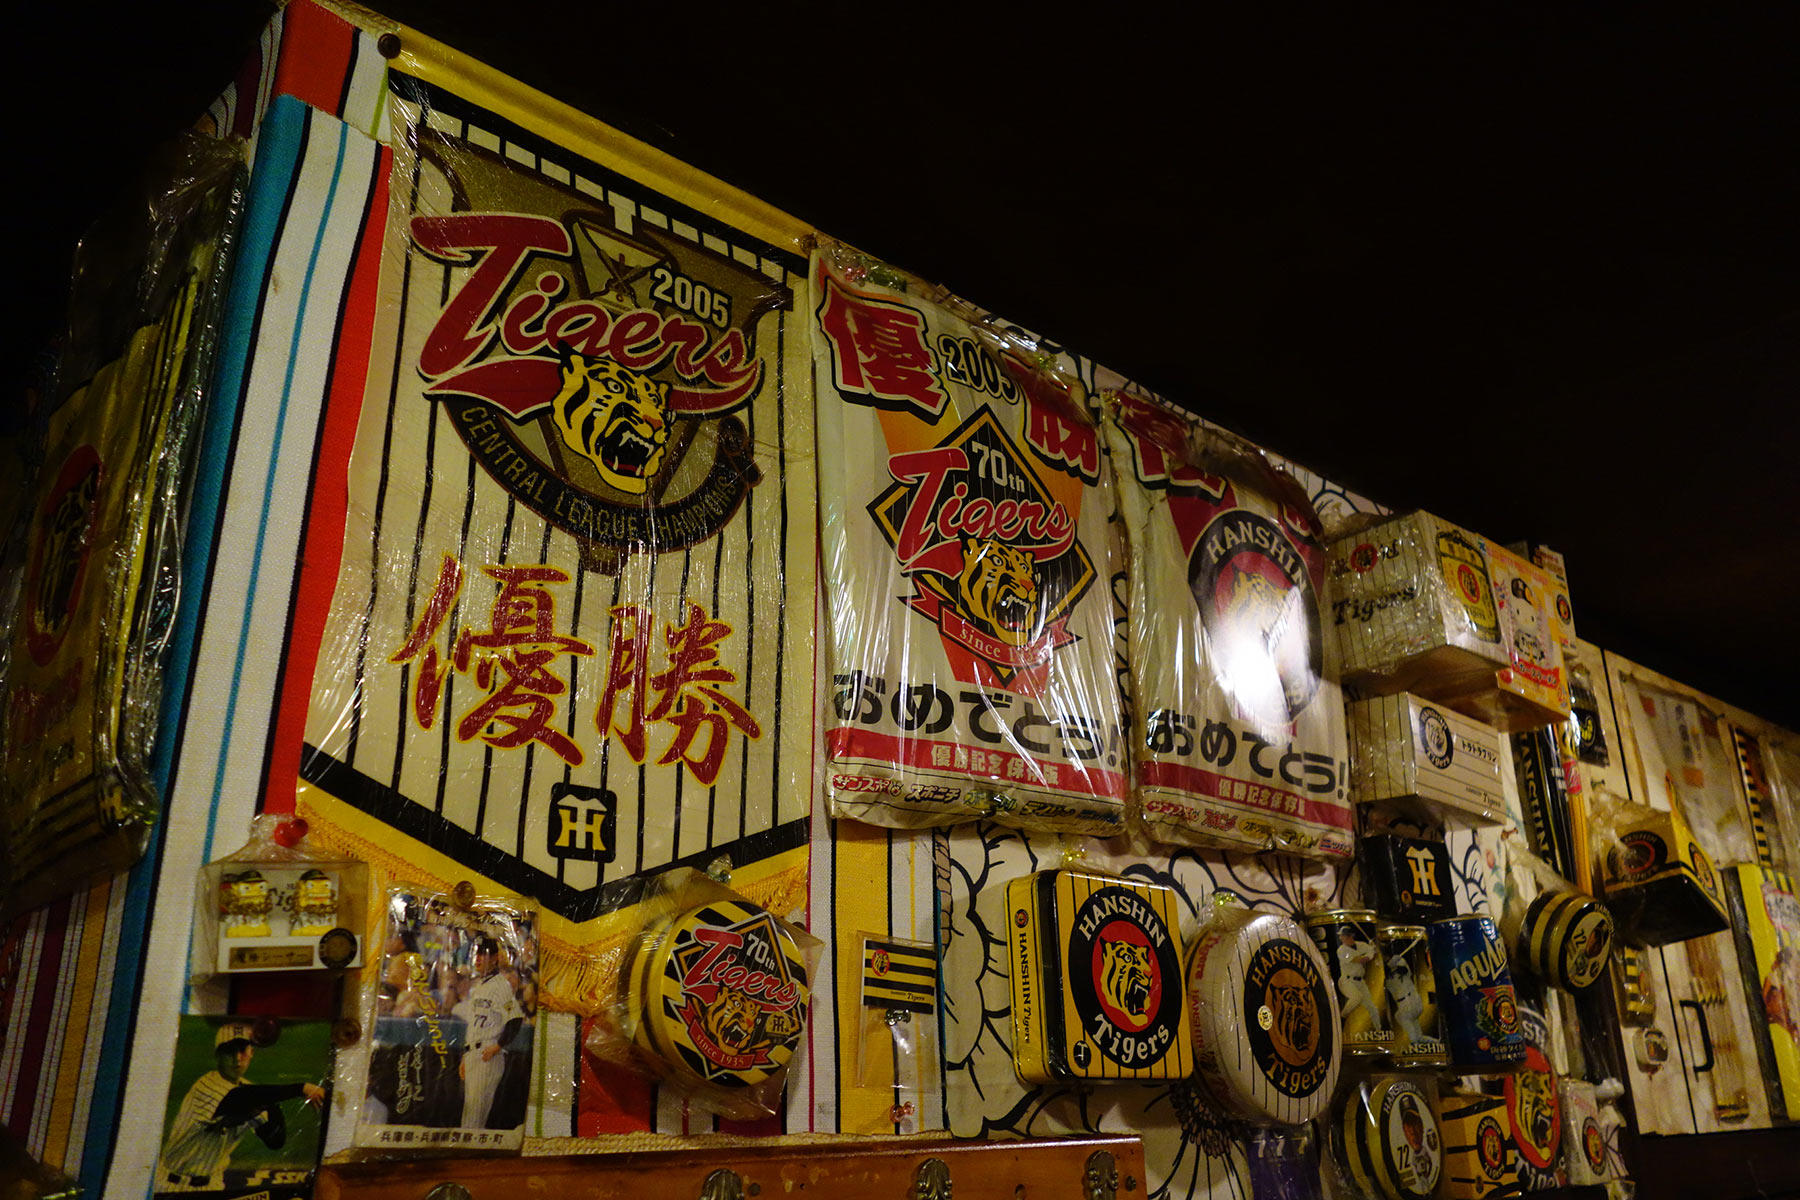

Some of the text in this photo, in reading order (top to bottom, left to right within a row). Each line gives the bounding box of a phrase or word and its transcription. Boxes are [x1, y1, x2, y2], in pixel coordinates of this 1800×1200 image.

[410, 211, 763, 412] Tigers
[652, 265, 731, 330] 2005
[818, 280, 948, 416] 優
[461, 405, 550, 502] CENTRAL
[554, 494, 639, 542] LEAGUE
[971, 441, 1026, 495] 70th
[888, 447, 1077, 580] Tigers
[1333, 587, 1415, 625] Tigers
[959, 625, 1001, 658] since
[387, 551, 763, 788] 優勝
[1078, 894, 1166, 949] HANSHIN
[683, 925, 802, 1012] Tigers
[747, 933, 776, 970] 70th
[1018, 932, 1031, 1006] HANSHIN
[1251, 944, 1319, 989] HANSHIN
[1094, 1013, 1170, 1063] Tigers
[1265, 1052, 1327, 1094] Tigers
[1397, 1144, 1410, 1170] 72
